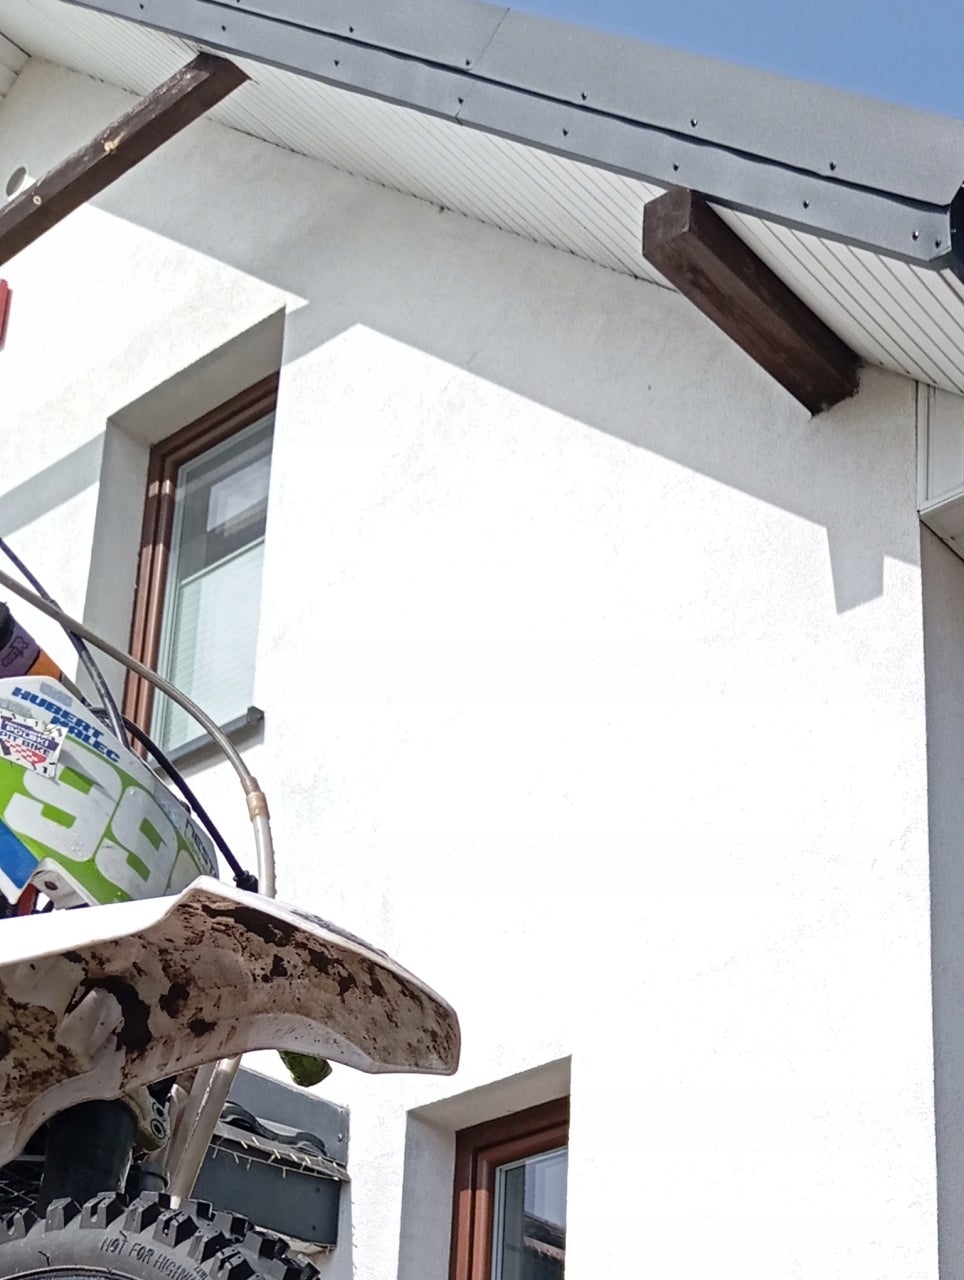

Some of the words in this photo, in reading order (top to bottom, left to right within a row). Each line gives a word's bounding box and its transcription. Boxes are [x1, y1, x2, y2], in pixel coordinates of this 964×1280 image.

[11, 686, 104, 739] HUBERT
[0, 731, 17, 743] PIT
[6, 725, 49, 747] POLSKI
[22, 738, 51, 756] BIKE
[100, 1236, 128, 1256] NOT
[128, 1242, 155, 1264] FOR
